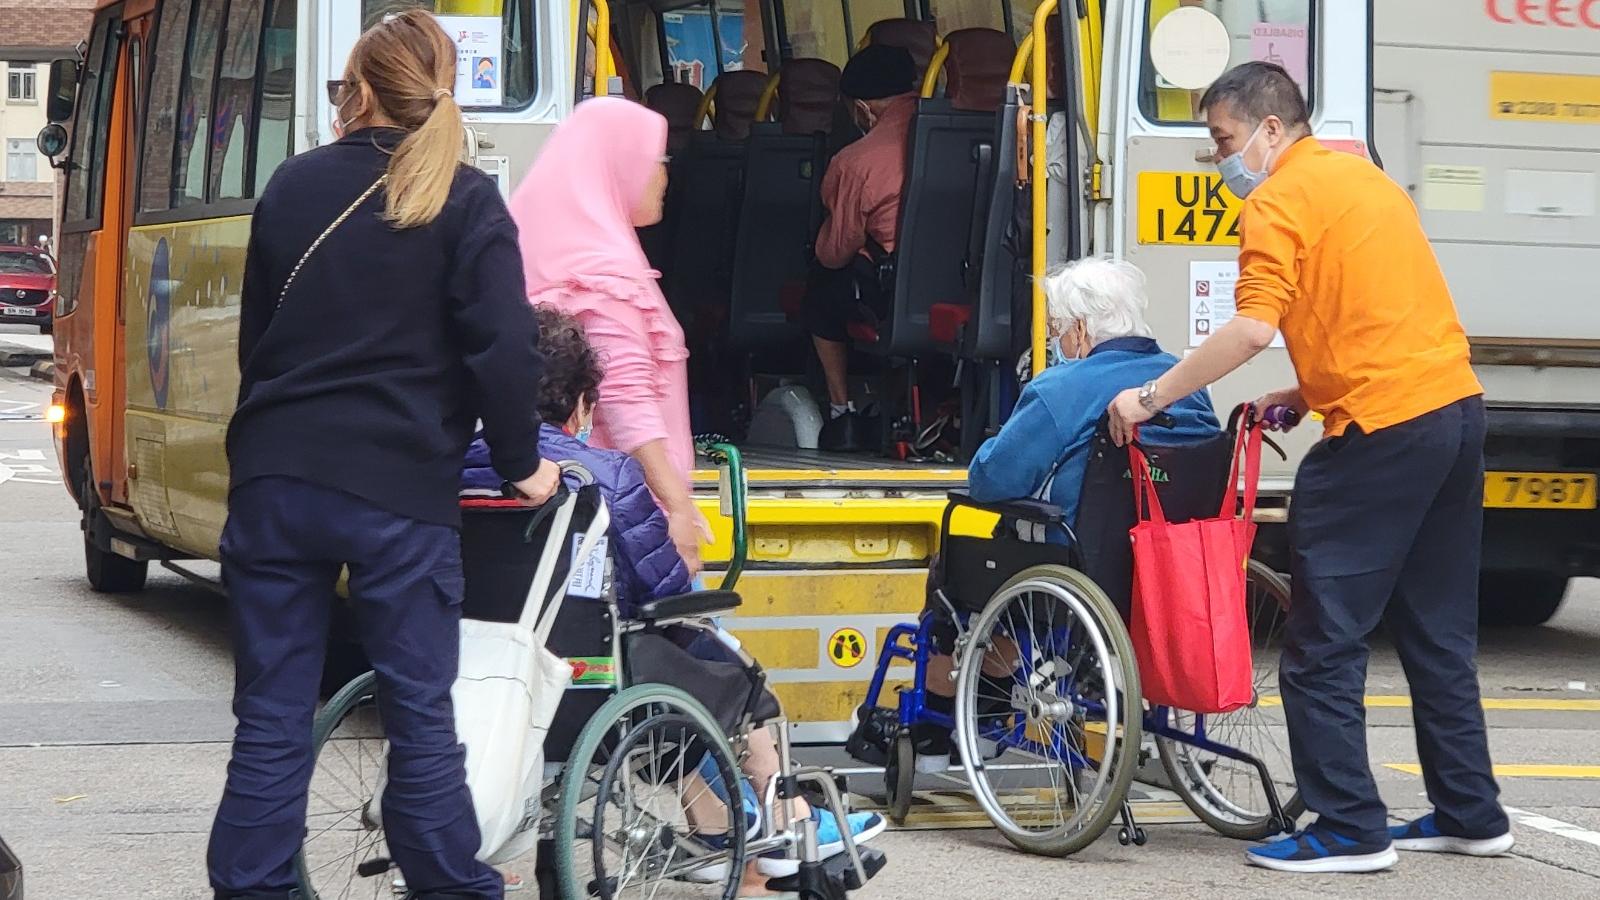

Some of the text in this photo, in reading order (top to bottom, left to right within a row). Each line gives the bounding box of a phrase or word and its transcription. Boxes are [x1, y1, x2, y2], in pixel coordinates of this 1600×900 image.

[1175, 175, 1228, 208] UK
[1122, 466, 1170, 482] AHA
[1503, 476, 1589, 504] 7987
